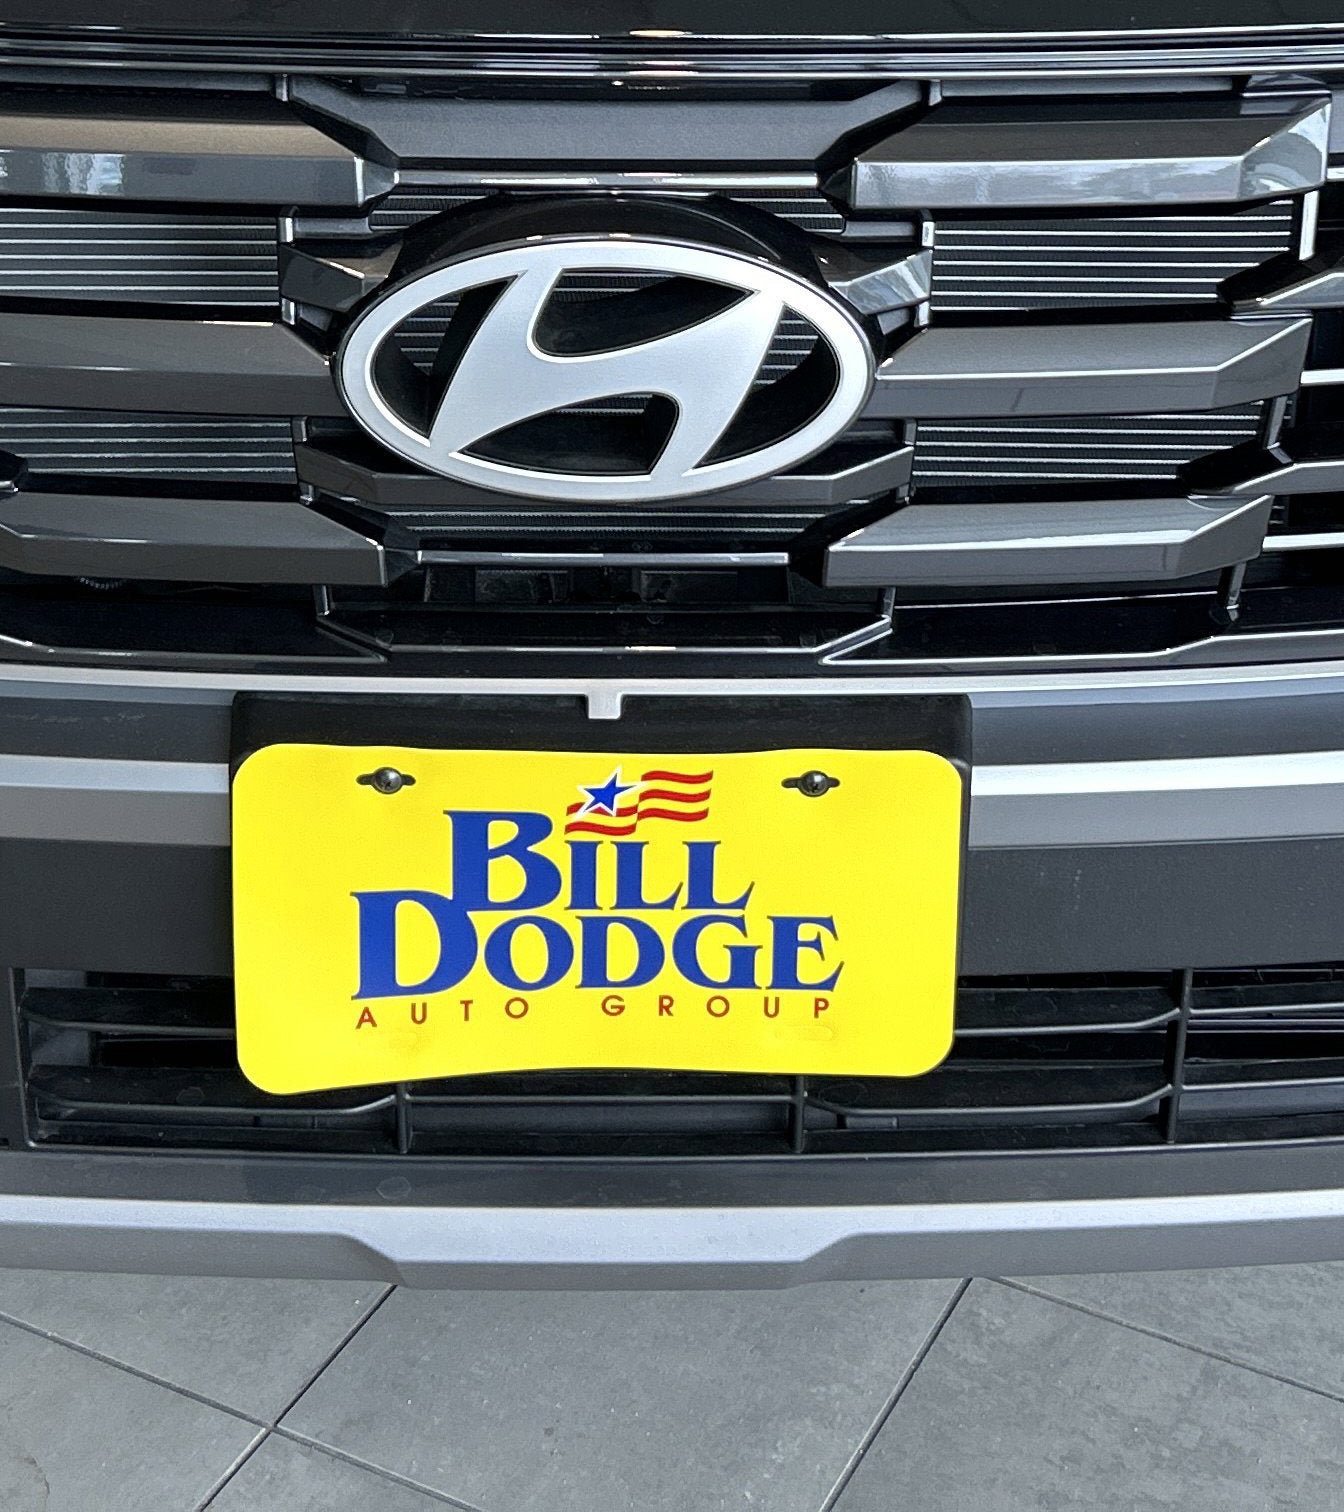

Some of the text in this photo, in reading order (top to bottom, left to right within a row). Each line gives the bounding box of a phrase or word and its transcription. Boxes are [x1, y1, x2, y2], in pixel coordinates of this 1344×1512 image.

[443, 810, 755, 912] BILL
[349, 889, 845, 1001] DODGE
[354, 994, 831, 1030] AUTO GROUP
